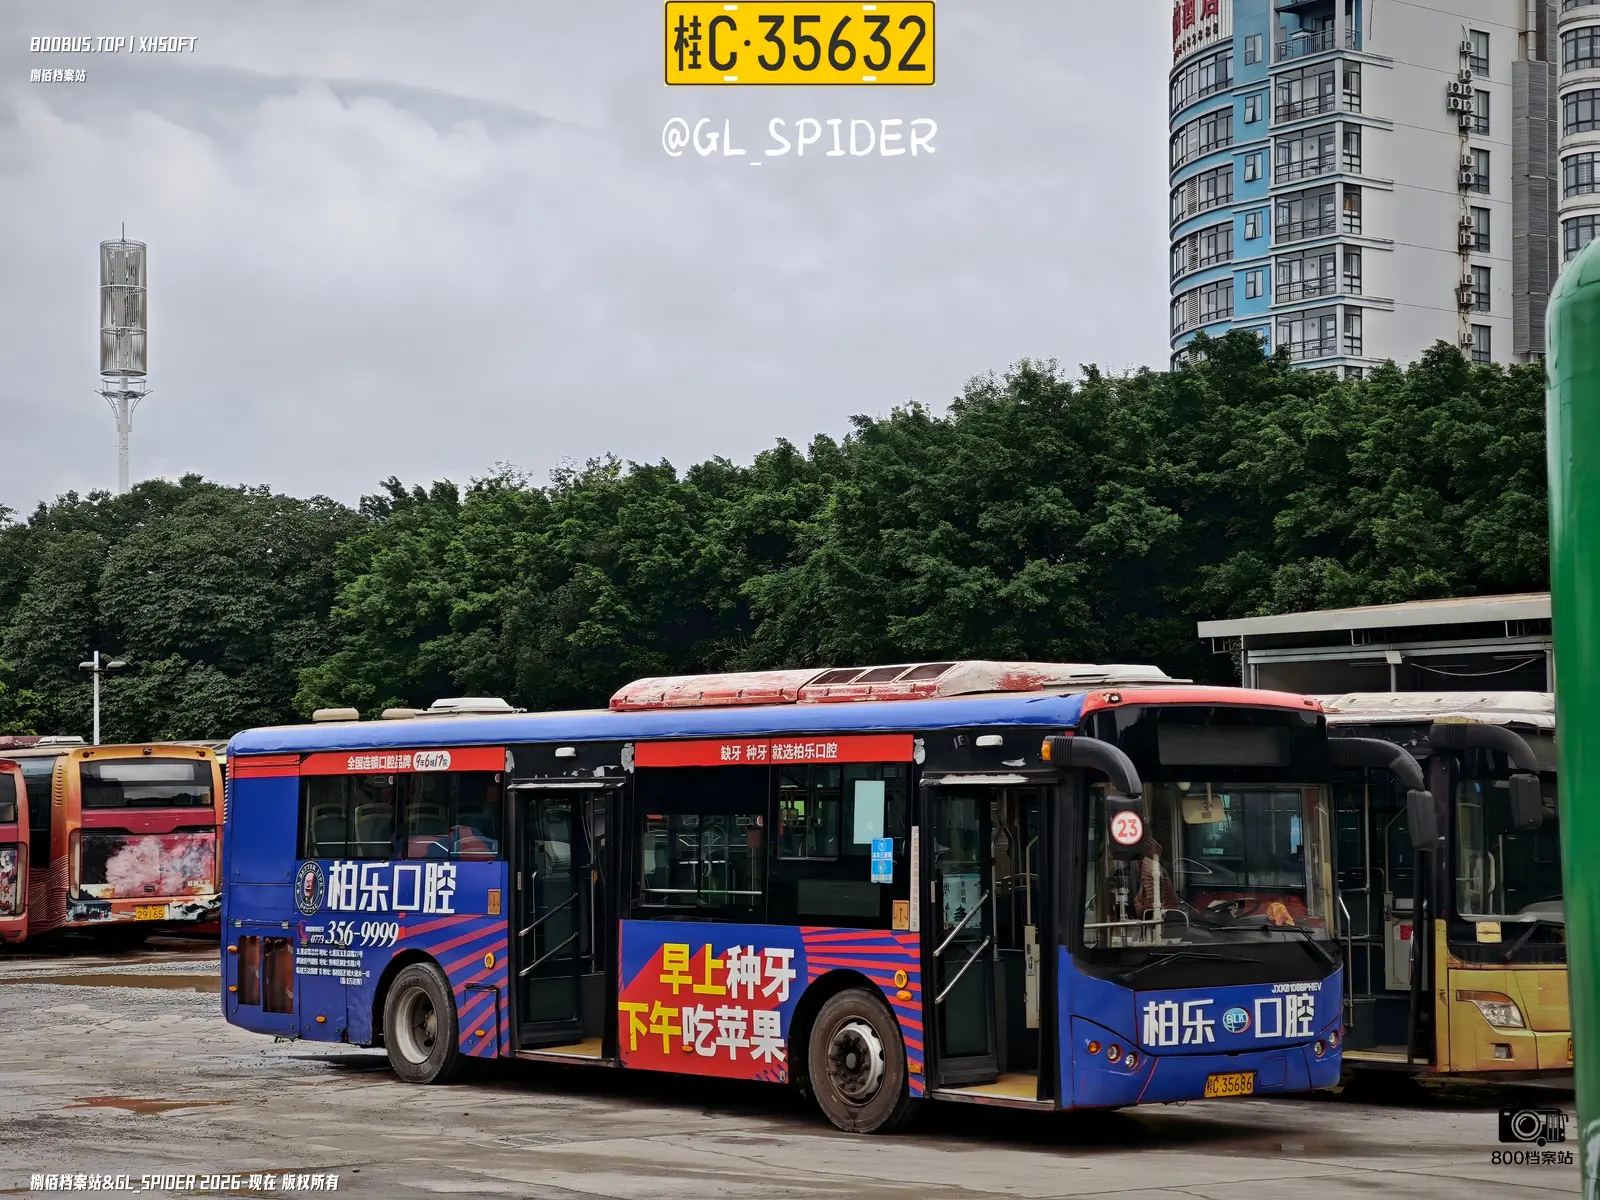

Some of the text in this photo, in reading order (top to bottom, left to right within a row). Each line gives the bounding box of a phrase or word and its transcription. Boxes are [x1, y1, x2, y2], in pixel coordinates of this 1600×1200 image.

[720, 742, 838, 762] 缺牙 种牙 就选柏乐口腔
[1117, 818, 1138, 838] 23
[327, 860, 457, 914] 柏乐口腔
[324, 920, 400, 948] 356-9999
[659, 942, 797, 1003] 早上种牙
[618, 1000, 786, 1064] 下午吃苹果
[1143, 993, 1315, 1047] 柏乐 口腔
